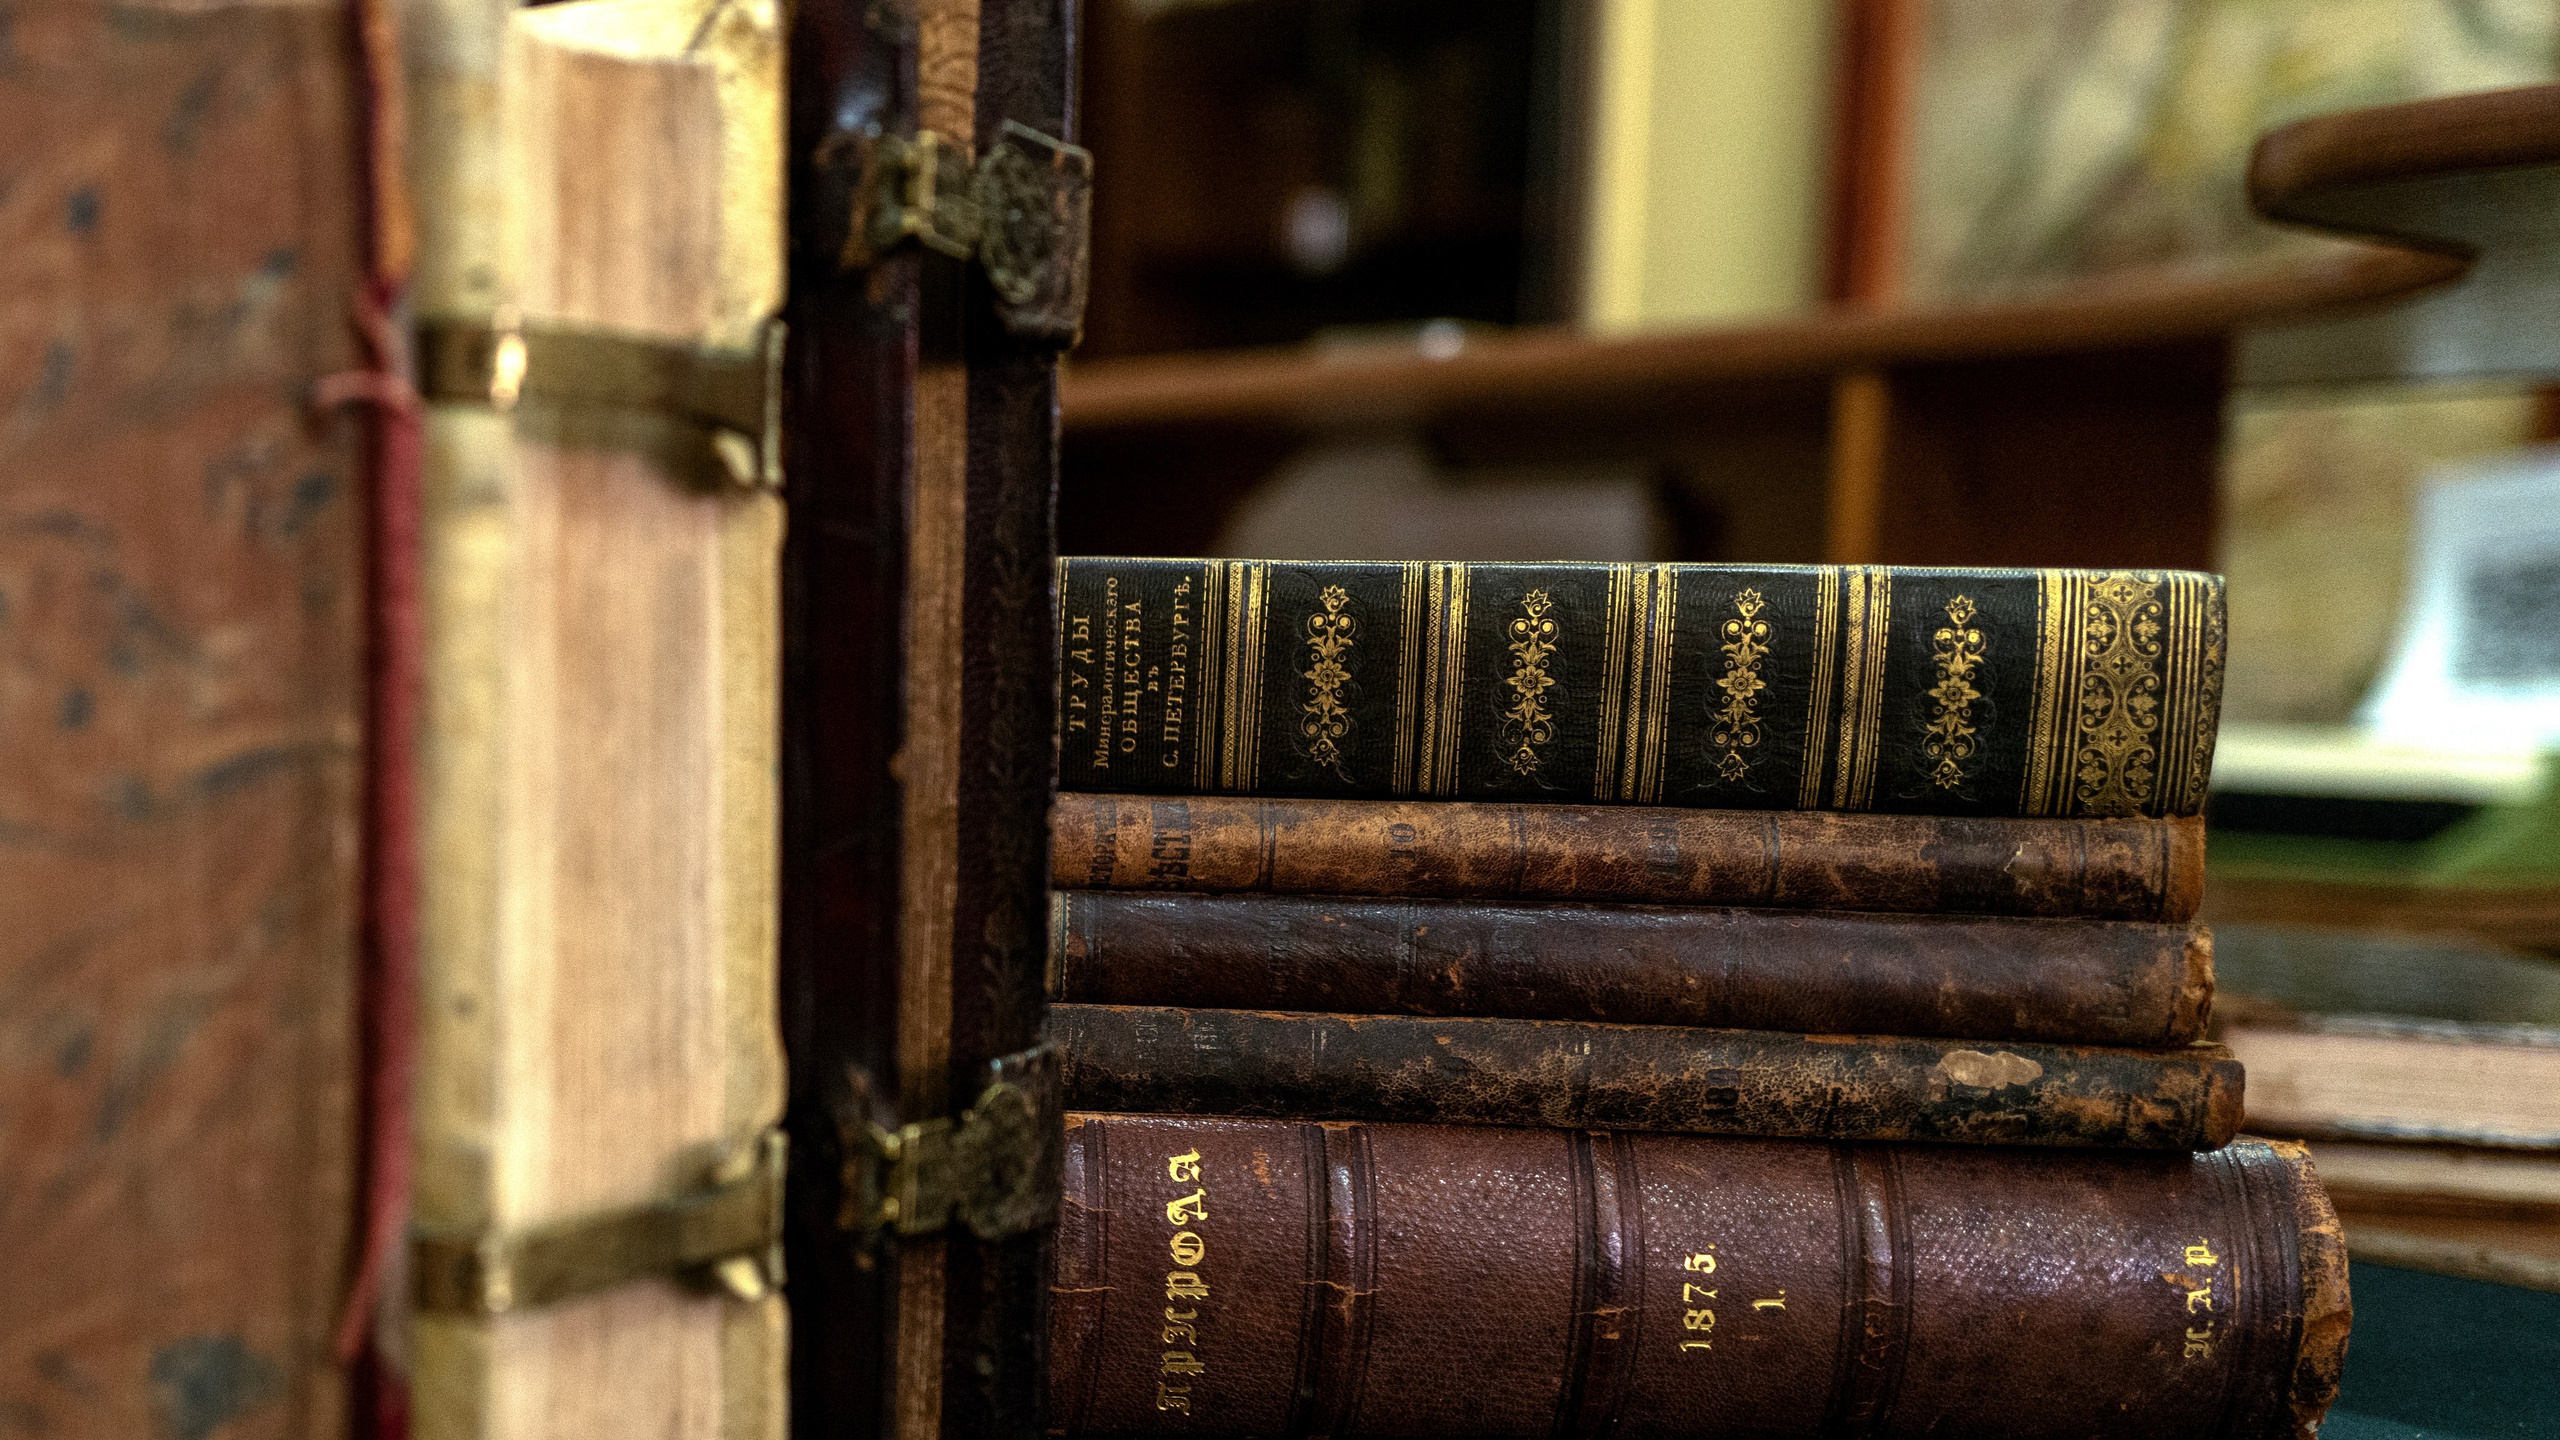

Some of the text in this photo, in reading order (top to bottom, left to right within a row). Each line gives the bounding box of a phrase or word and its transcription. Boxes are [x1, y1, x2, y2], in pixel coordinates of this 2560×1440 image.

[1069, 614, 1094, 731] ТРУДЫ
[1093, 577, 1119, 769] Минералогическаго
[1120, 598, 1142, 753] ОБЩЕСТВА
[1147, 665, 1159, 692] въ
[1162, 575, 1191, 768] С. ПЕТЕРБУРГѢ.
[1156, 1146, 1211, 1416] ПРИРОДА
[1678, 1242, 1719, 1353] 1875.
[1751, 1288, 1787, 1311] 1.
